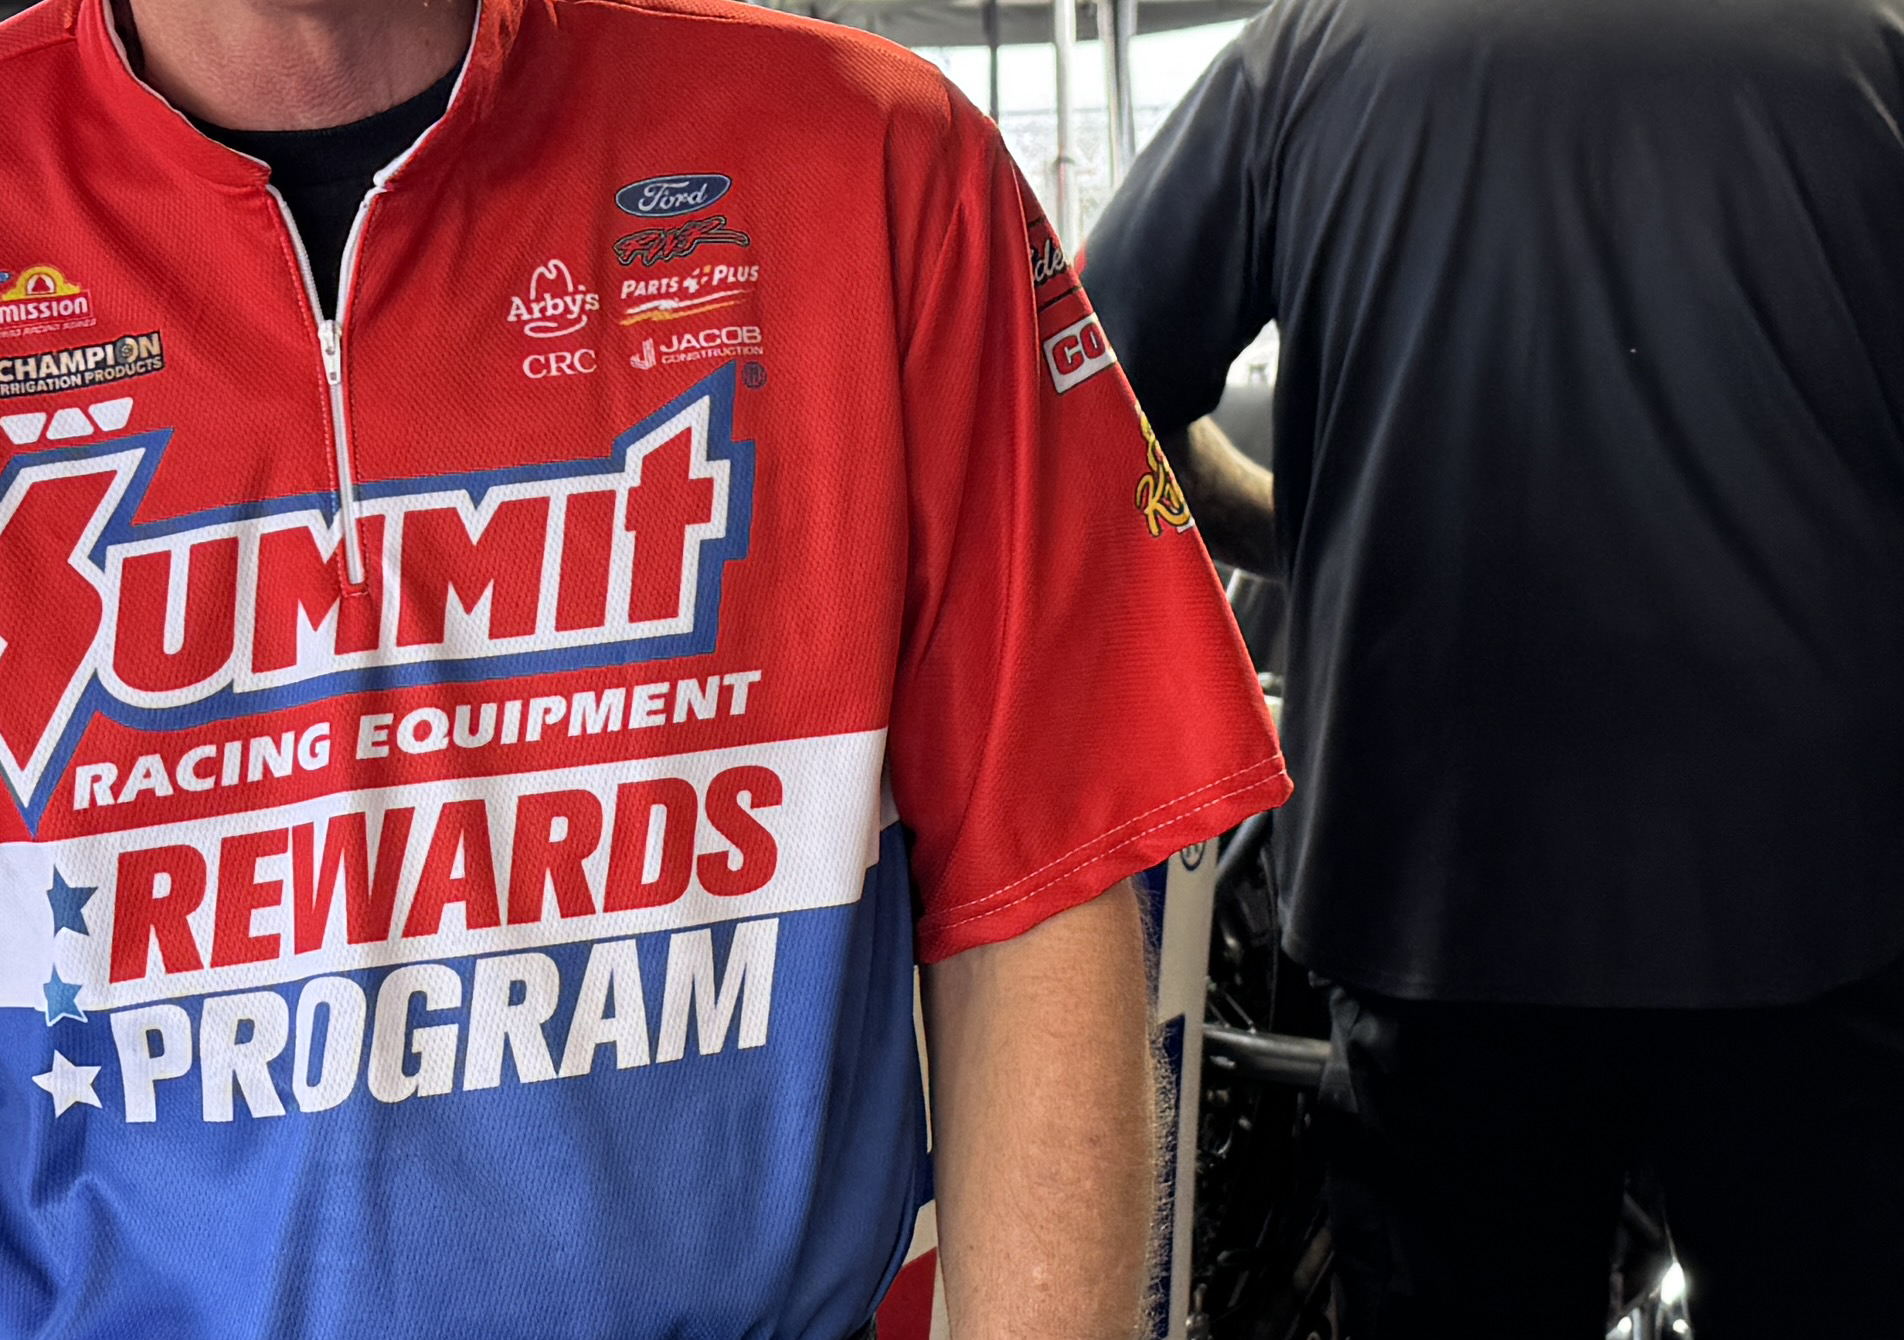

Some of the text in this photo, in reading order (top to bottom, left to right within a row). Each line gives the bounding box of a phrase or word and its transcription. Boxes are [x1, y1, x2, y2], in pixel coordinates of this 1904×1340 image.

[638, 181, 708, 211] Ford
[621, 265, 760, 299] PARTS PLUS
[507, 284, 600, 322] Arby's
[659, 326, 762, 354] JACOB
[661, 345, 764, 364] CONSTRUCTION
[84, 356, 163, 386] PRODUCTS
[523, 348, 597, 379] CRC
[73, 670, 762, 811] RACING EQUIPMENT
[108, 763, 783, 982] REWARDS
[109, 917, 779, 1123] PROGRAM
